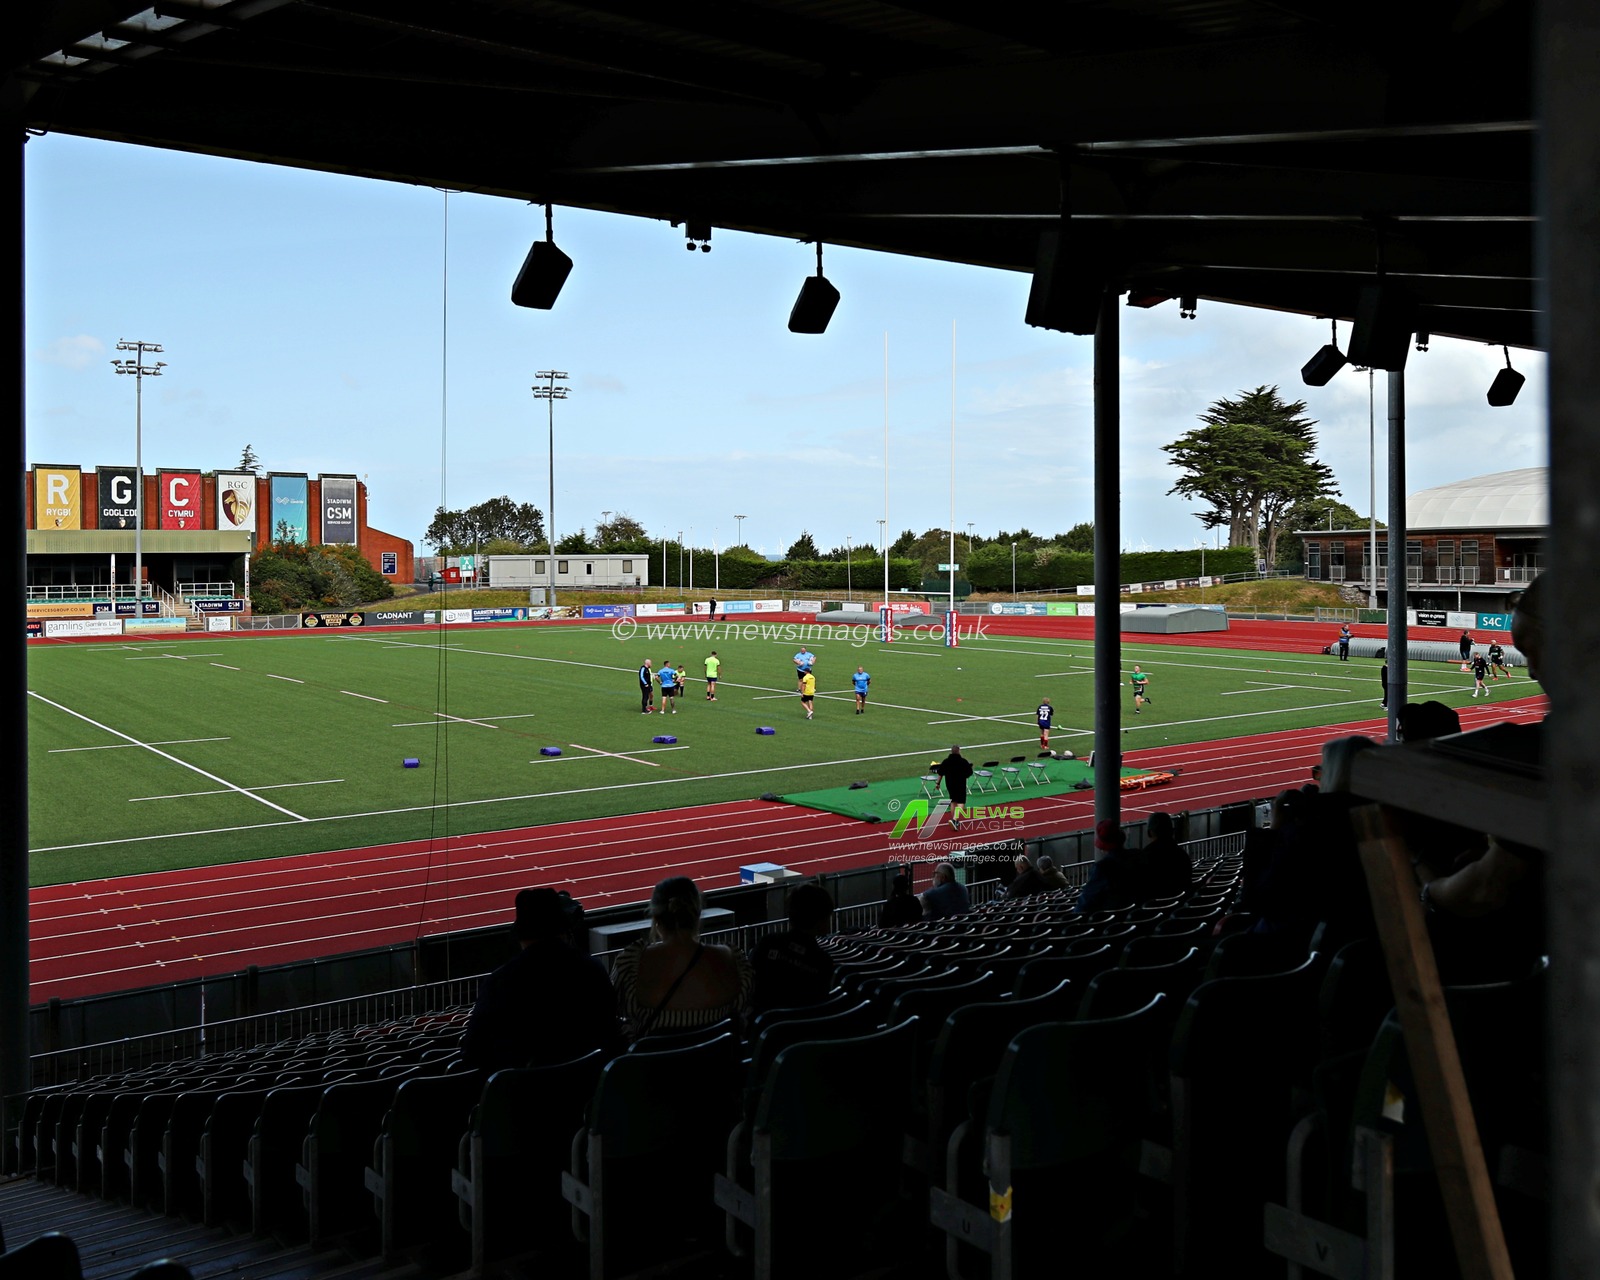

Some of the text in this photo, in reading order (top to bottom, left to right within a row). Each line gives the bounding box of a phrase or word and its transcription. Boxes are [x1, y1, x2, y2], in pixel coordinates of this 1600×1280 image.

[48, 474, 69, 505] R
[111, 476, 132, 505] G
[227, 481, 248, 490] RGC
[169, 478, 189, 507] C
[46, 508, 71, 516] RYGBI
[168, 510, 194, 518] CYMRU
[326, 507, 352, 519] CSM
[376, 612, 413, 620] CADNANT
[1482, 616, 1502, 627] S4C
[48, 621, 84, 633] gamlins
